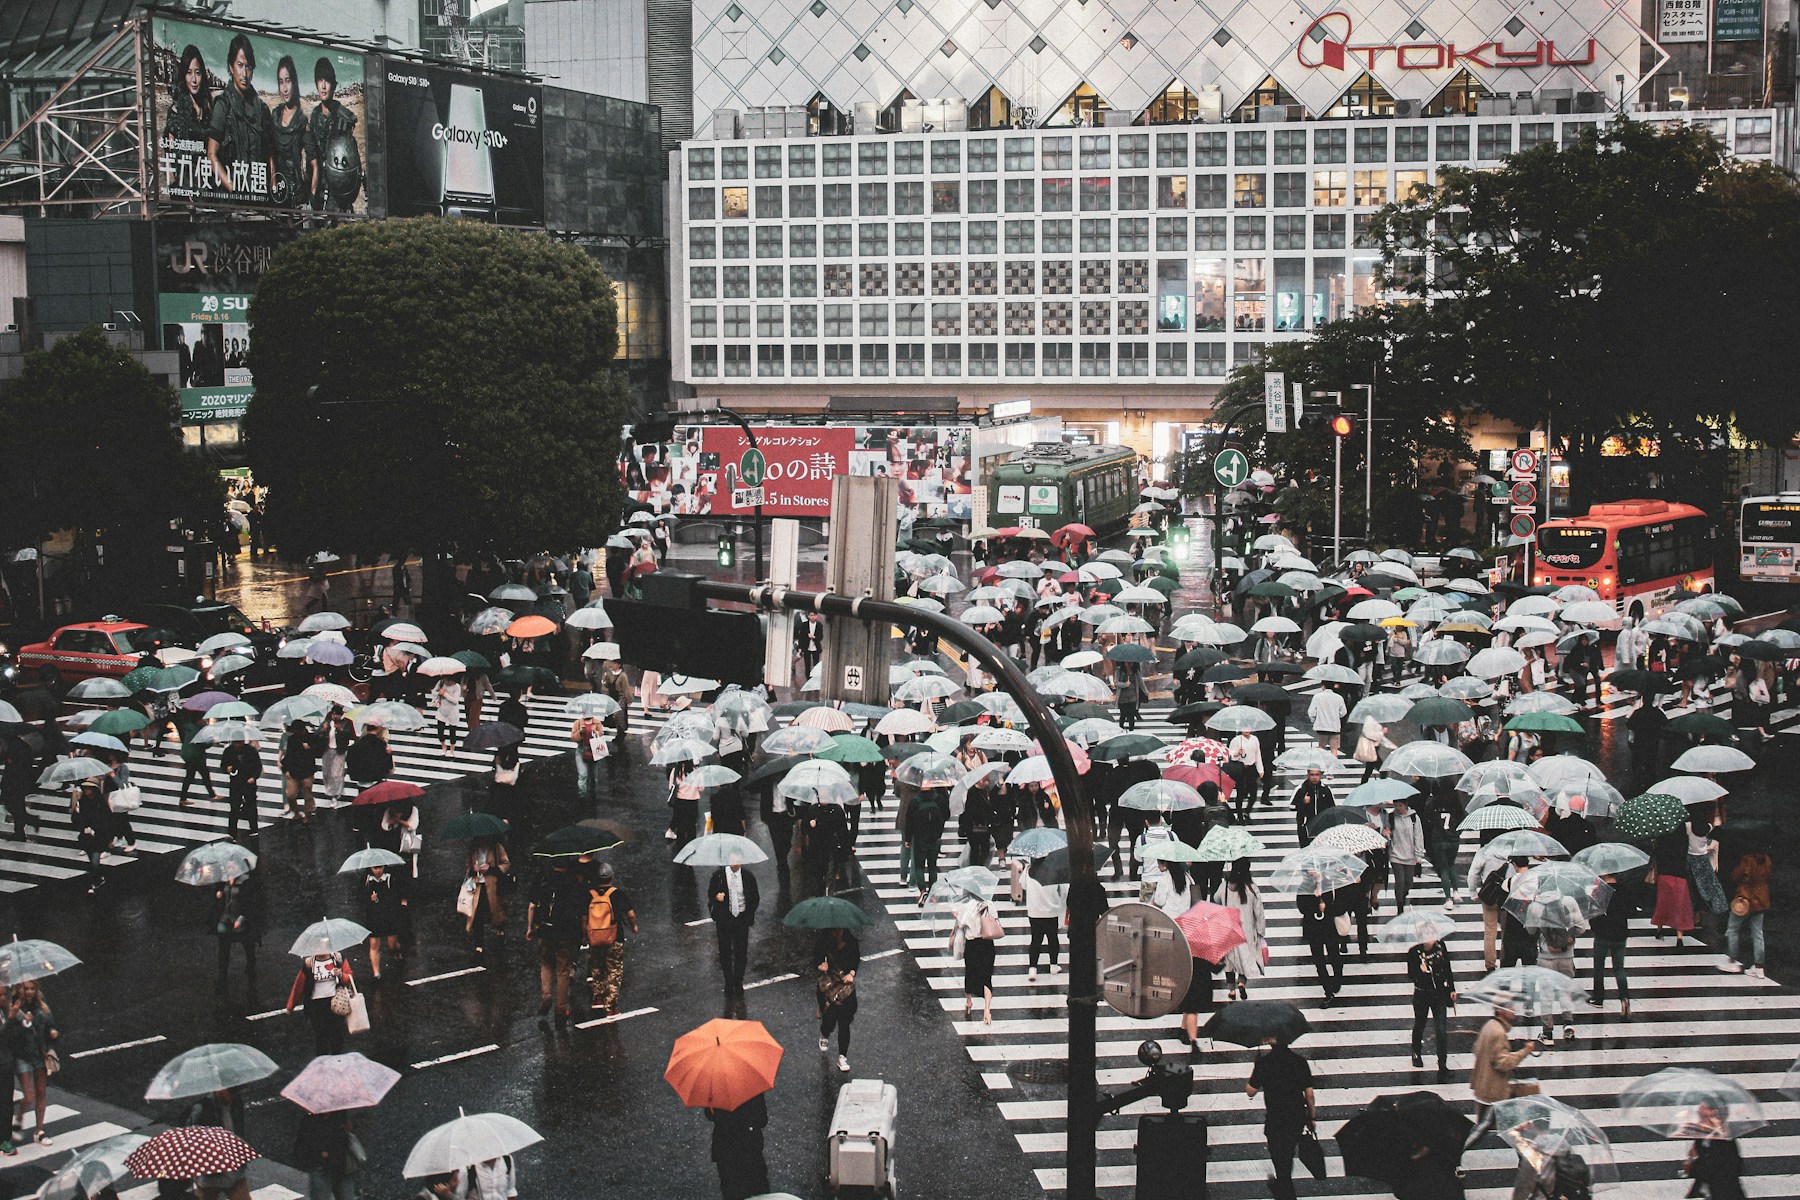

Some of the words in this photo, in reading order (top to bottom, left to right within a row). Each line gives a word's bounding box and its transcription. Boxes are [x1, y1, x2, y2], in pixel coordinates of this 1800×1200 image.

[1663, 11, 1703, 19] カスタマー
[1663, 19, 1703, 27] センターへ
[1347, 39, 1595, 71] TOKYU
[387, 72, 408, 86] Galaxy
[431, 122, 481, 150] Galaxy
[483, 129, 508, 149] S10+
[159, 152, 268, 194] ギガ使い放題
[171, 240, 208, 274] JR
[222, 296, 251, 310] SU
[191, 312, 212, 321] Friday
[725, 452, 836, 481] aoの詩
[780, 494, 791, 506] in
[792, 494, 829, 506] Stores
[1440, 812, 1450, 830] 7
